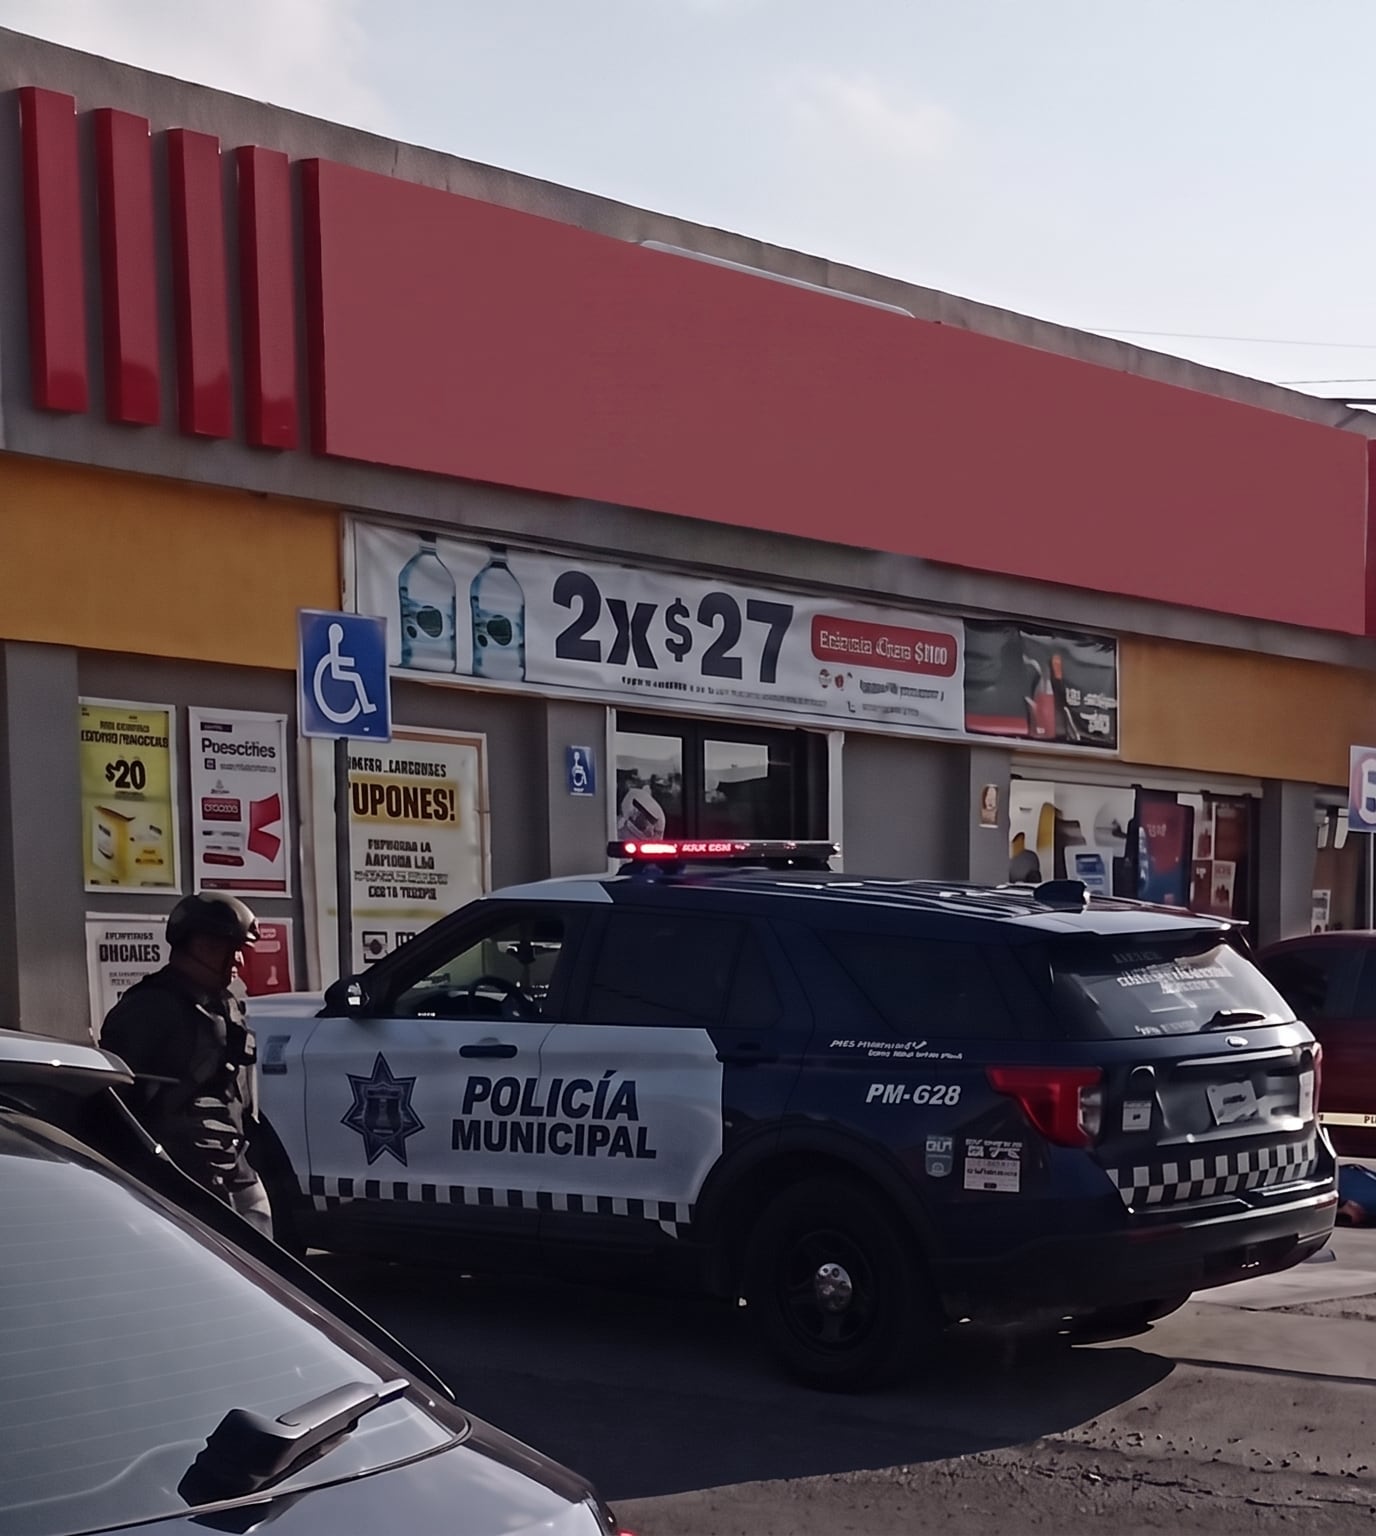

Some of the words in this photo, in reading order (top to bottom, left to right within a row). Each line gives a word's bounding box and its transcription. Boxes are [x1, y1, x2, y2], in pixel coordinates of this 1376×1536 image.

[105, 759, 146, 791] $20
[349, 781, 456, 822] UPONES!
[461, 1069, 639, 1122] POLICÍA
[451, 1118, 657, 1160] MUNICIPAL
